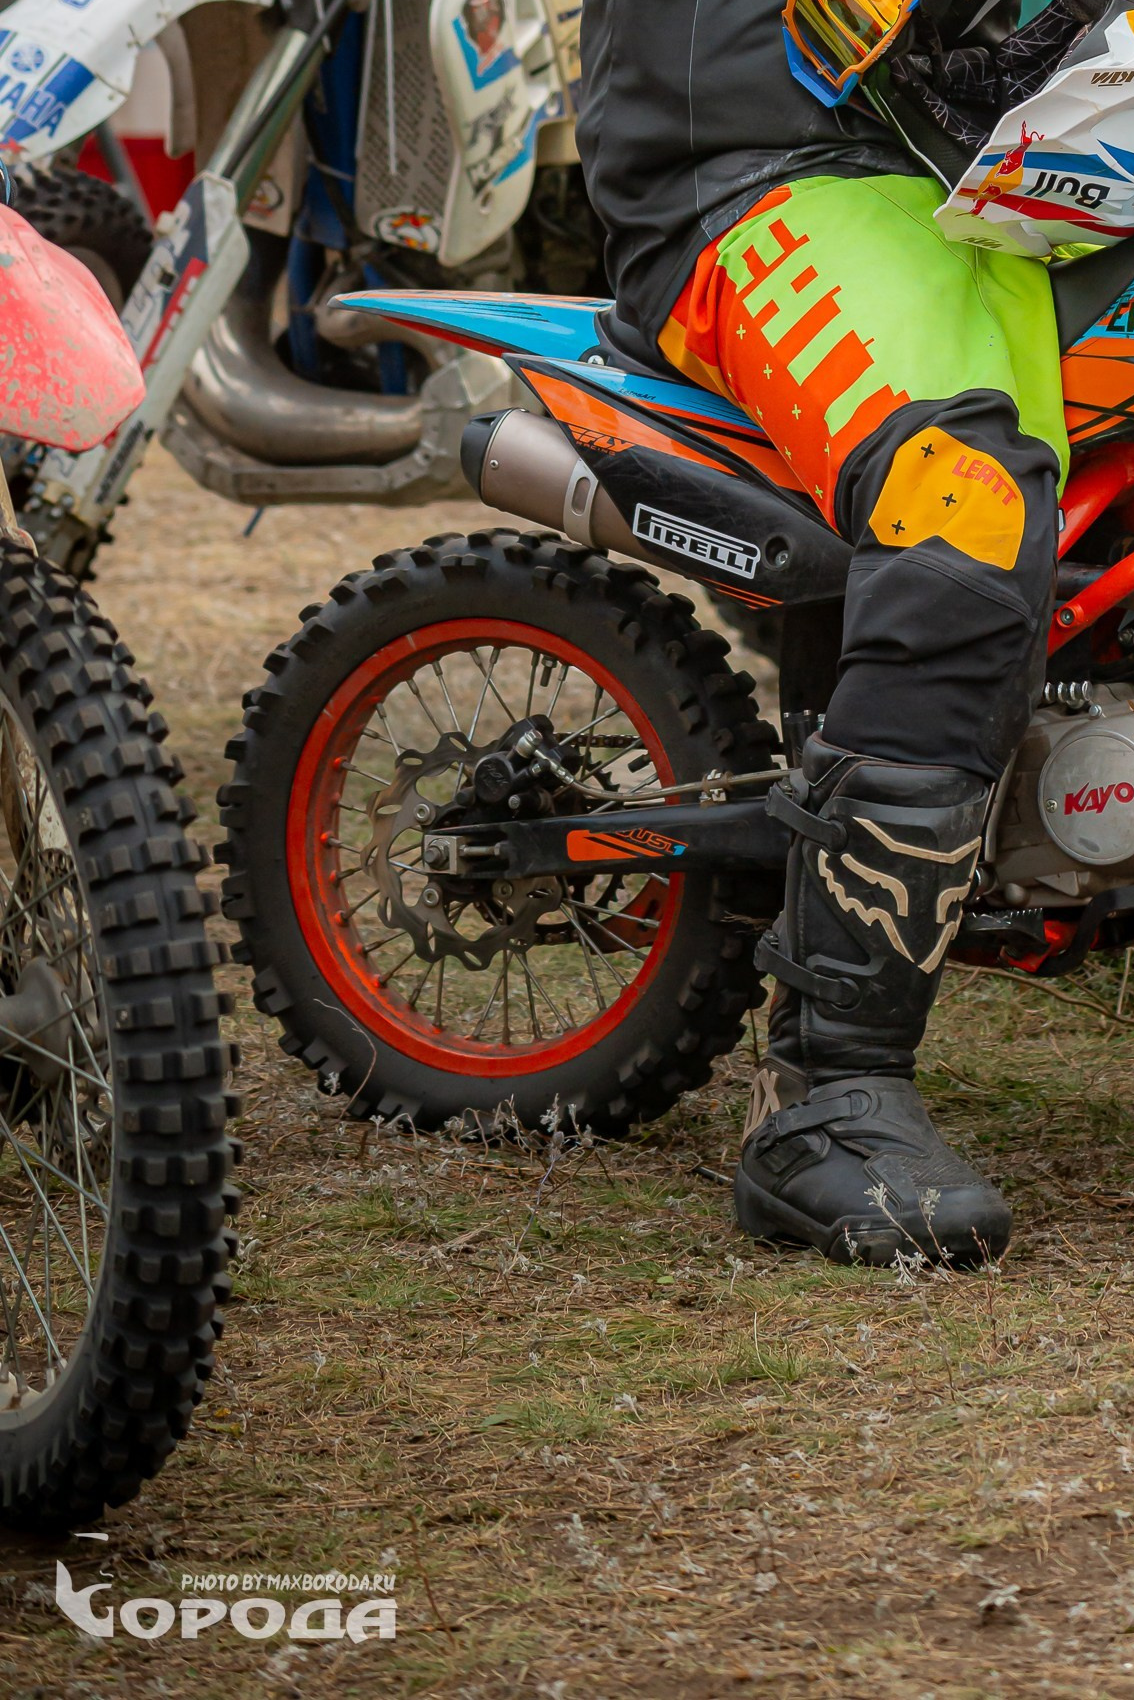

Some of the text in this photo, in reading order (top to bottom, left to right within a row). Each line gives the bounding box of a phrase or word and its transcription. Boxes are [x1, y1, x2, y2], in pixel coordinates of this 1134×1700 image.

[1026, 171, 1112, 210] Bull
[567, 424, 637, 453] FLY
[575, 440, 616, 457] RACING
[951, 454, 1019, 506] LEATT
[637, 506, 759, 573] PIRELLI
